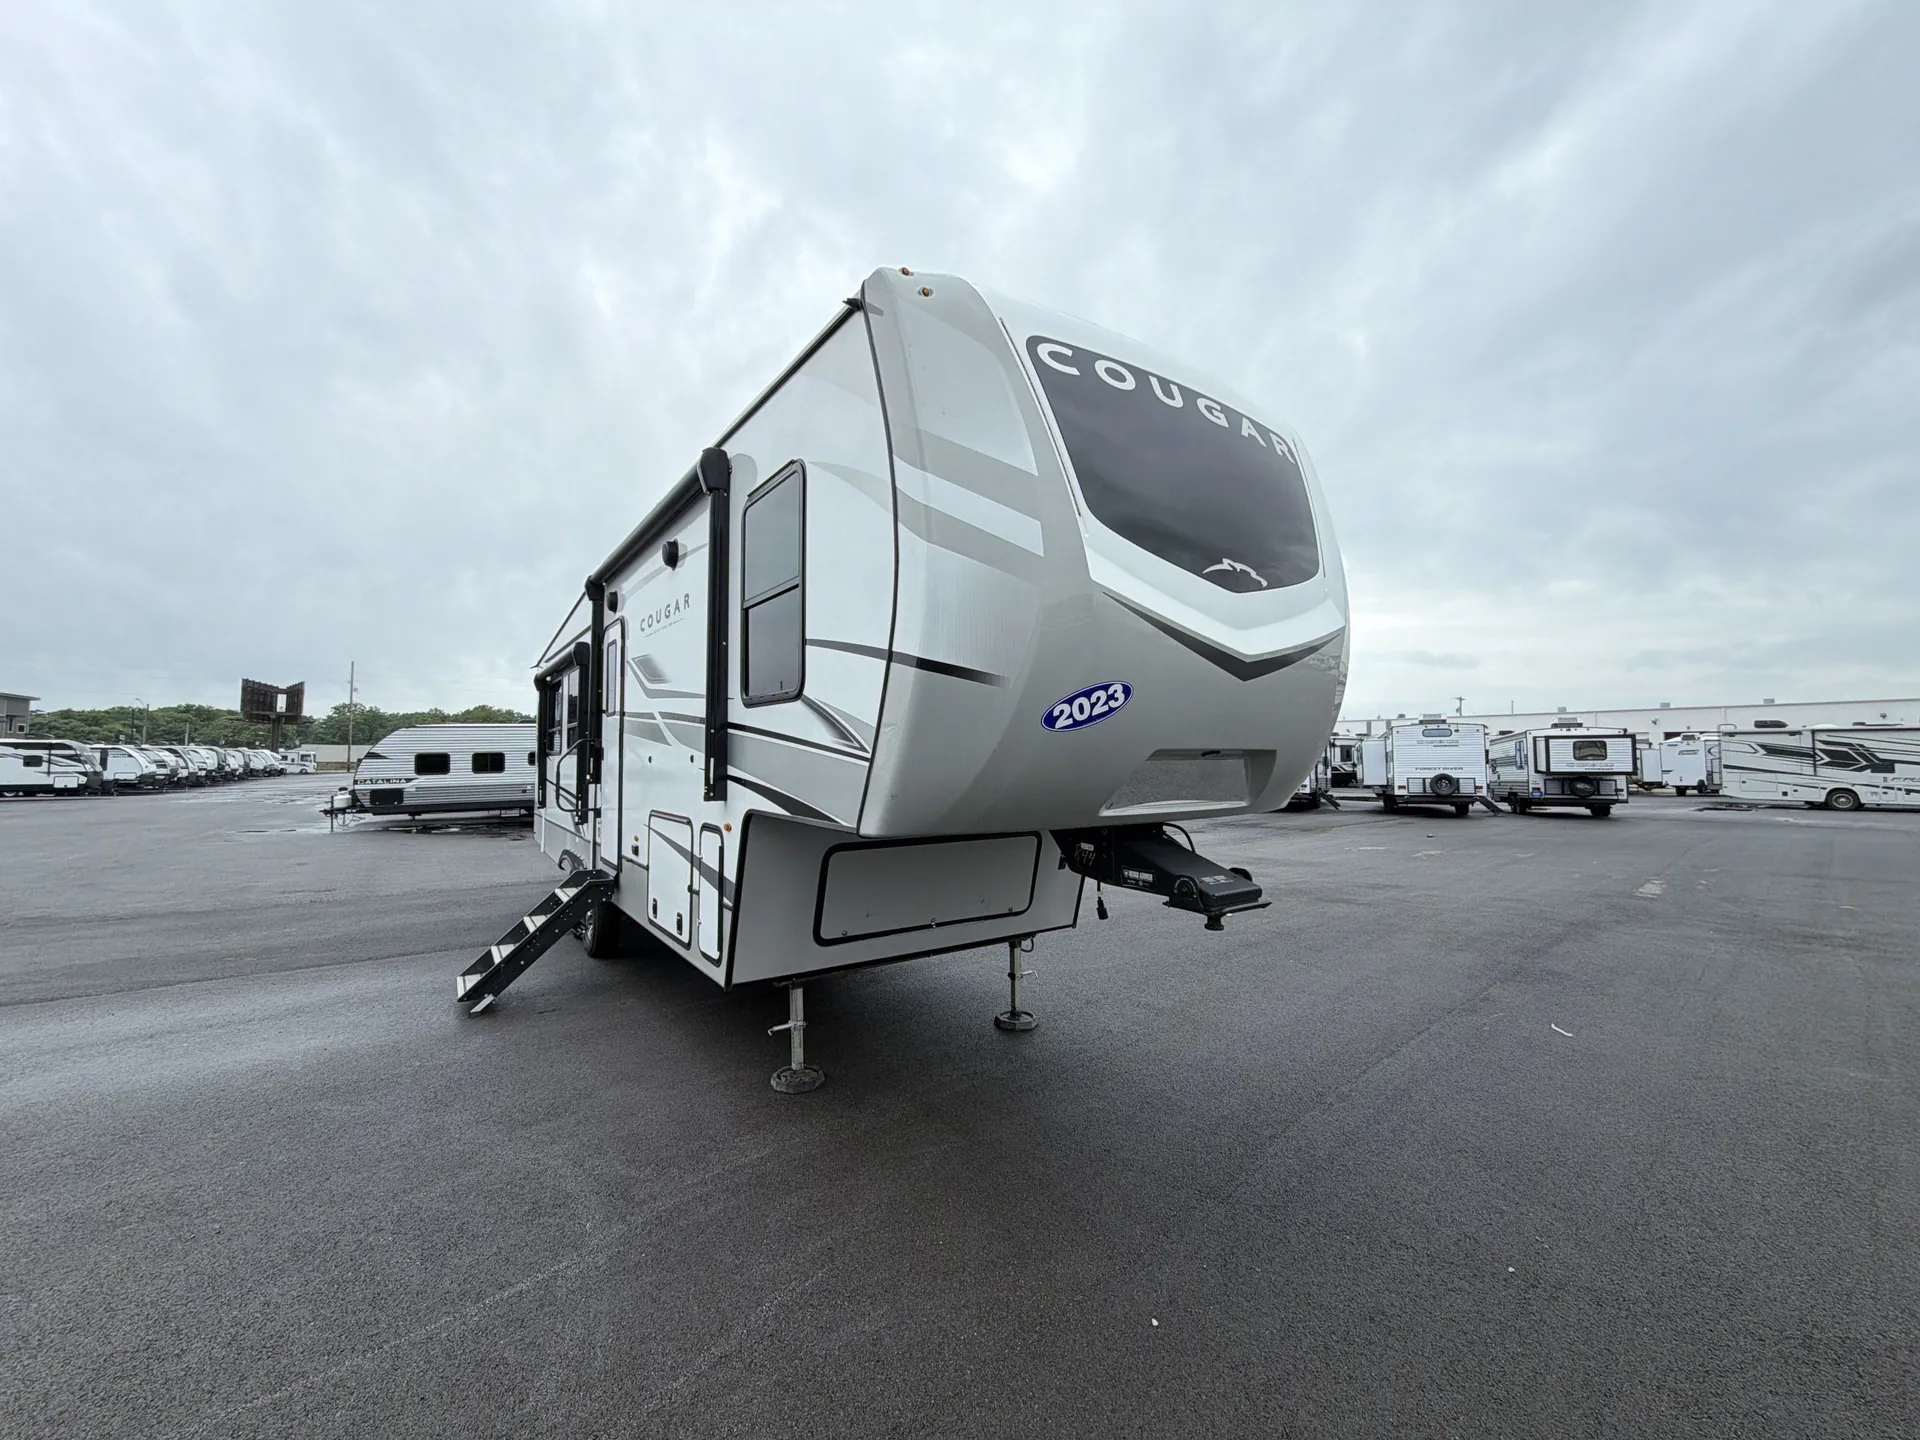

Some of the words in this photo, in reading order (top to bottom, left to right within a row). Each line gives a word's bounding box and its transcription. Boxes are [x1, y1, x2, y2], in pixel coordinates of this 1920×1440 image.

[1036, 342, 1296, 465] COUGAR
[640, 593, 690, 632] COUGAR
[1052, 683, 1126, 730] 2023
